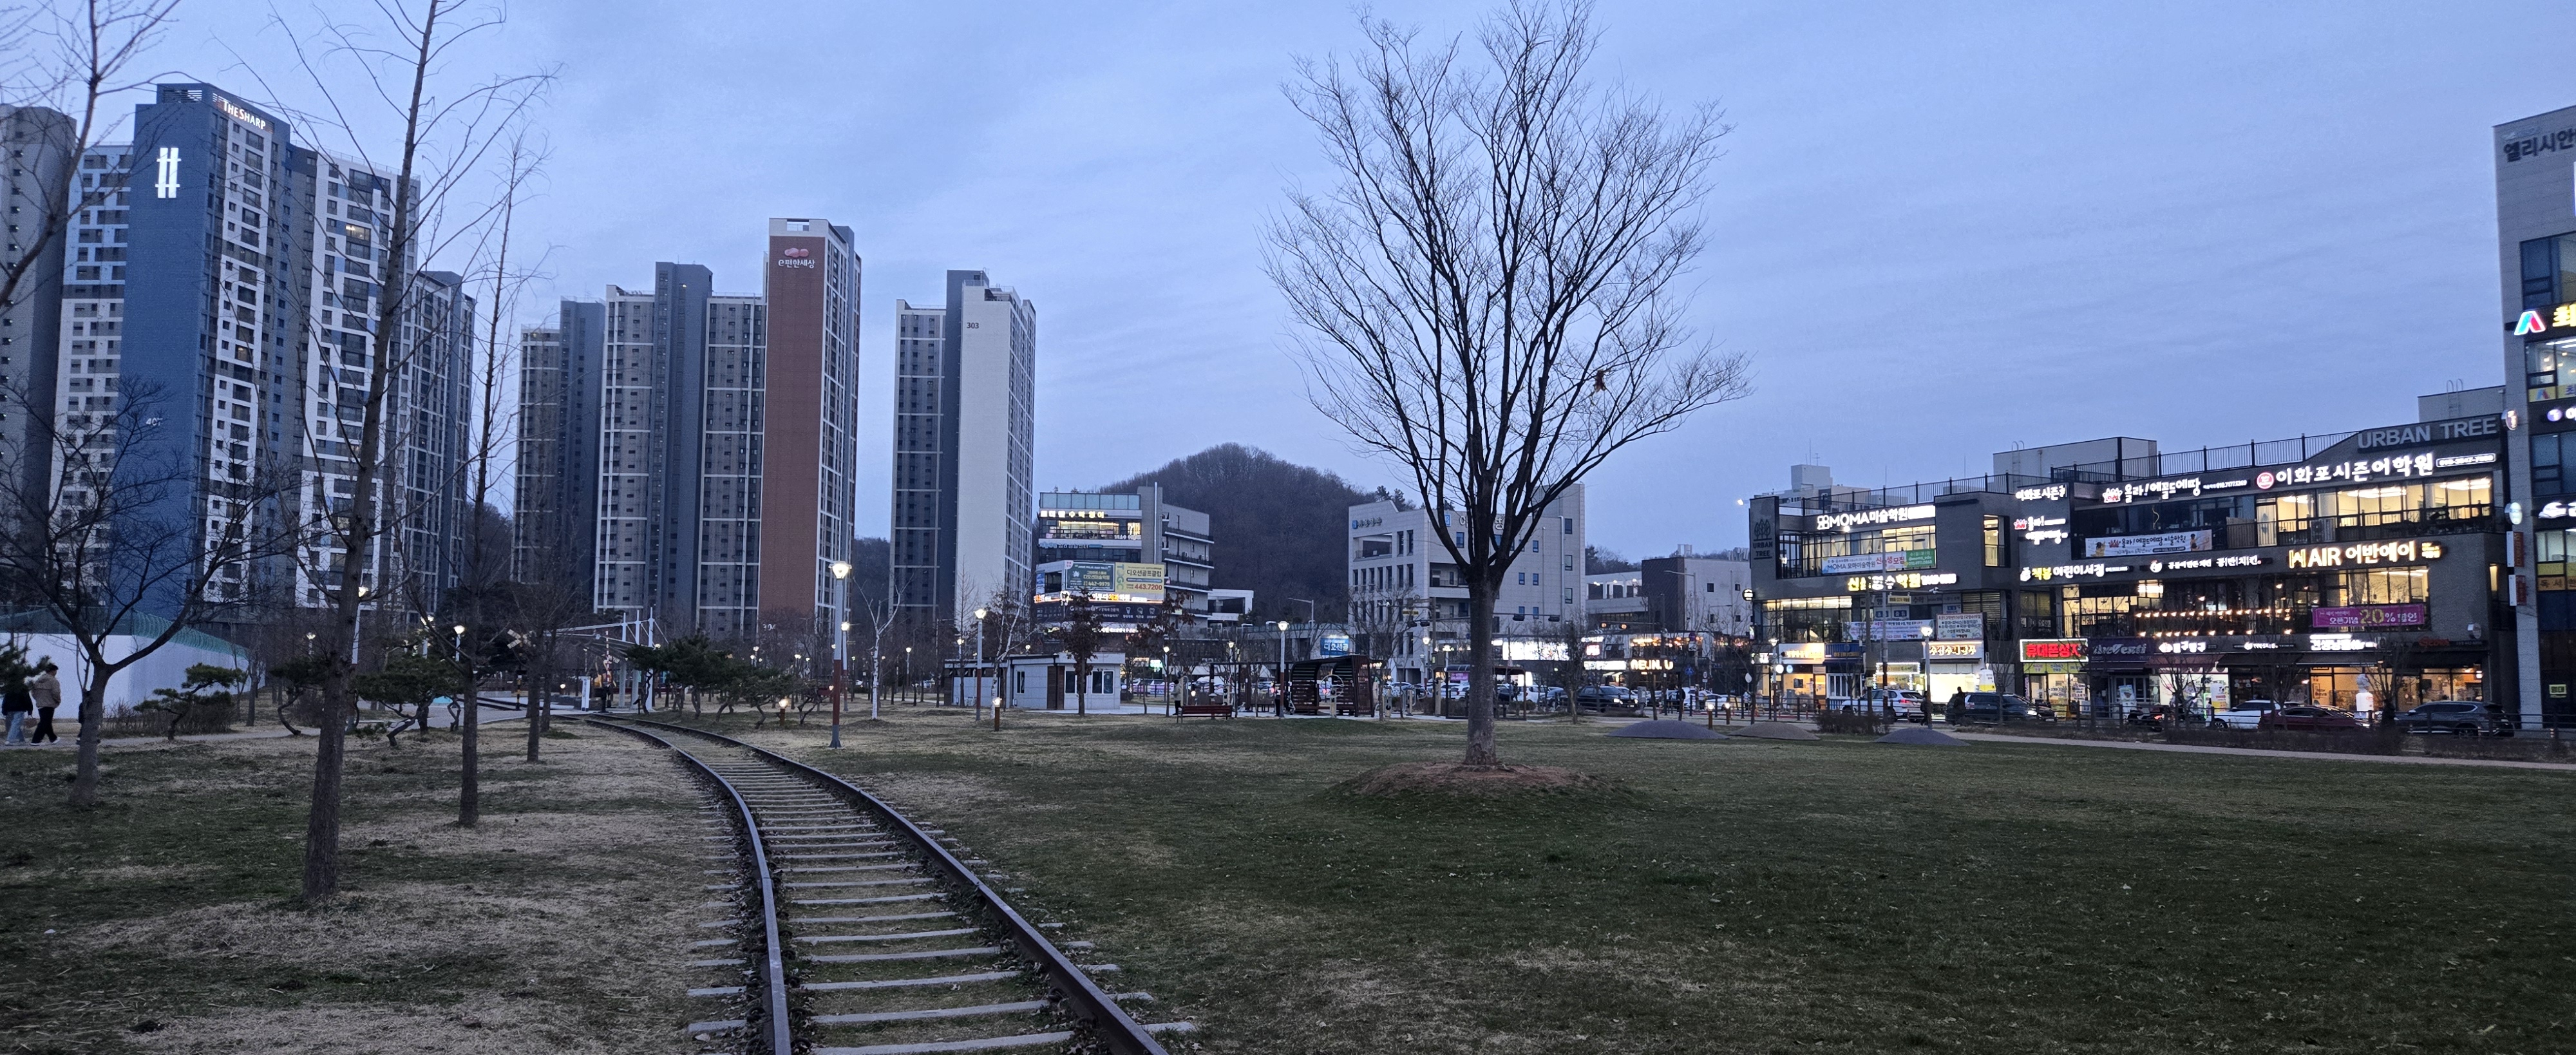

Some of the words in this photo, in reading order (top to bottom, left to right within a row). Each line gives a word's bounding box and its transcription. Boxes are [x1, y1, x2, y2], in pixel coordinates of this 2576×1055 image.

[778, 259, 815, 269] e편한세상
[146, 417, 163, 426] 407
[2358, 424, 2431, 450] URBAN
[2439, 417, 2497, 439] TREE
[2276, 451, 2434, 482] 이화포시즌어학원
[2345, 540, 2416, 564] 어반에이
[2329, 616, 2358, 625] 오픈기념
